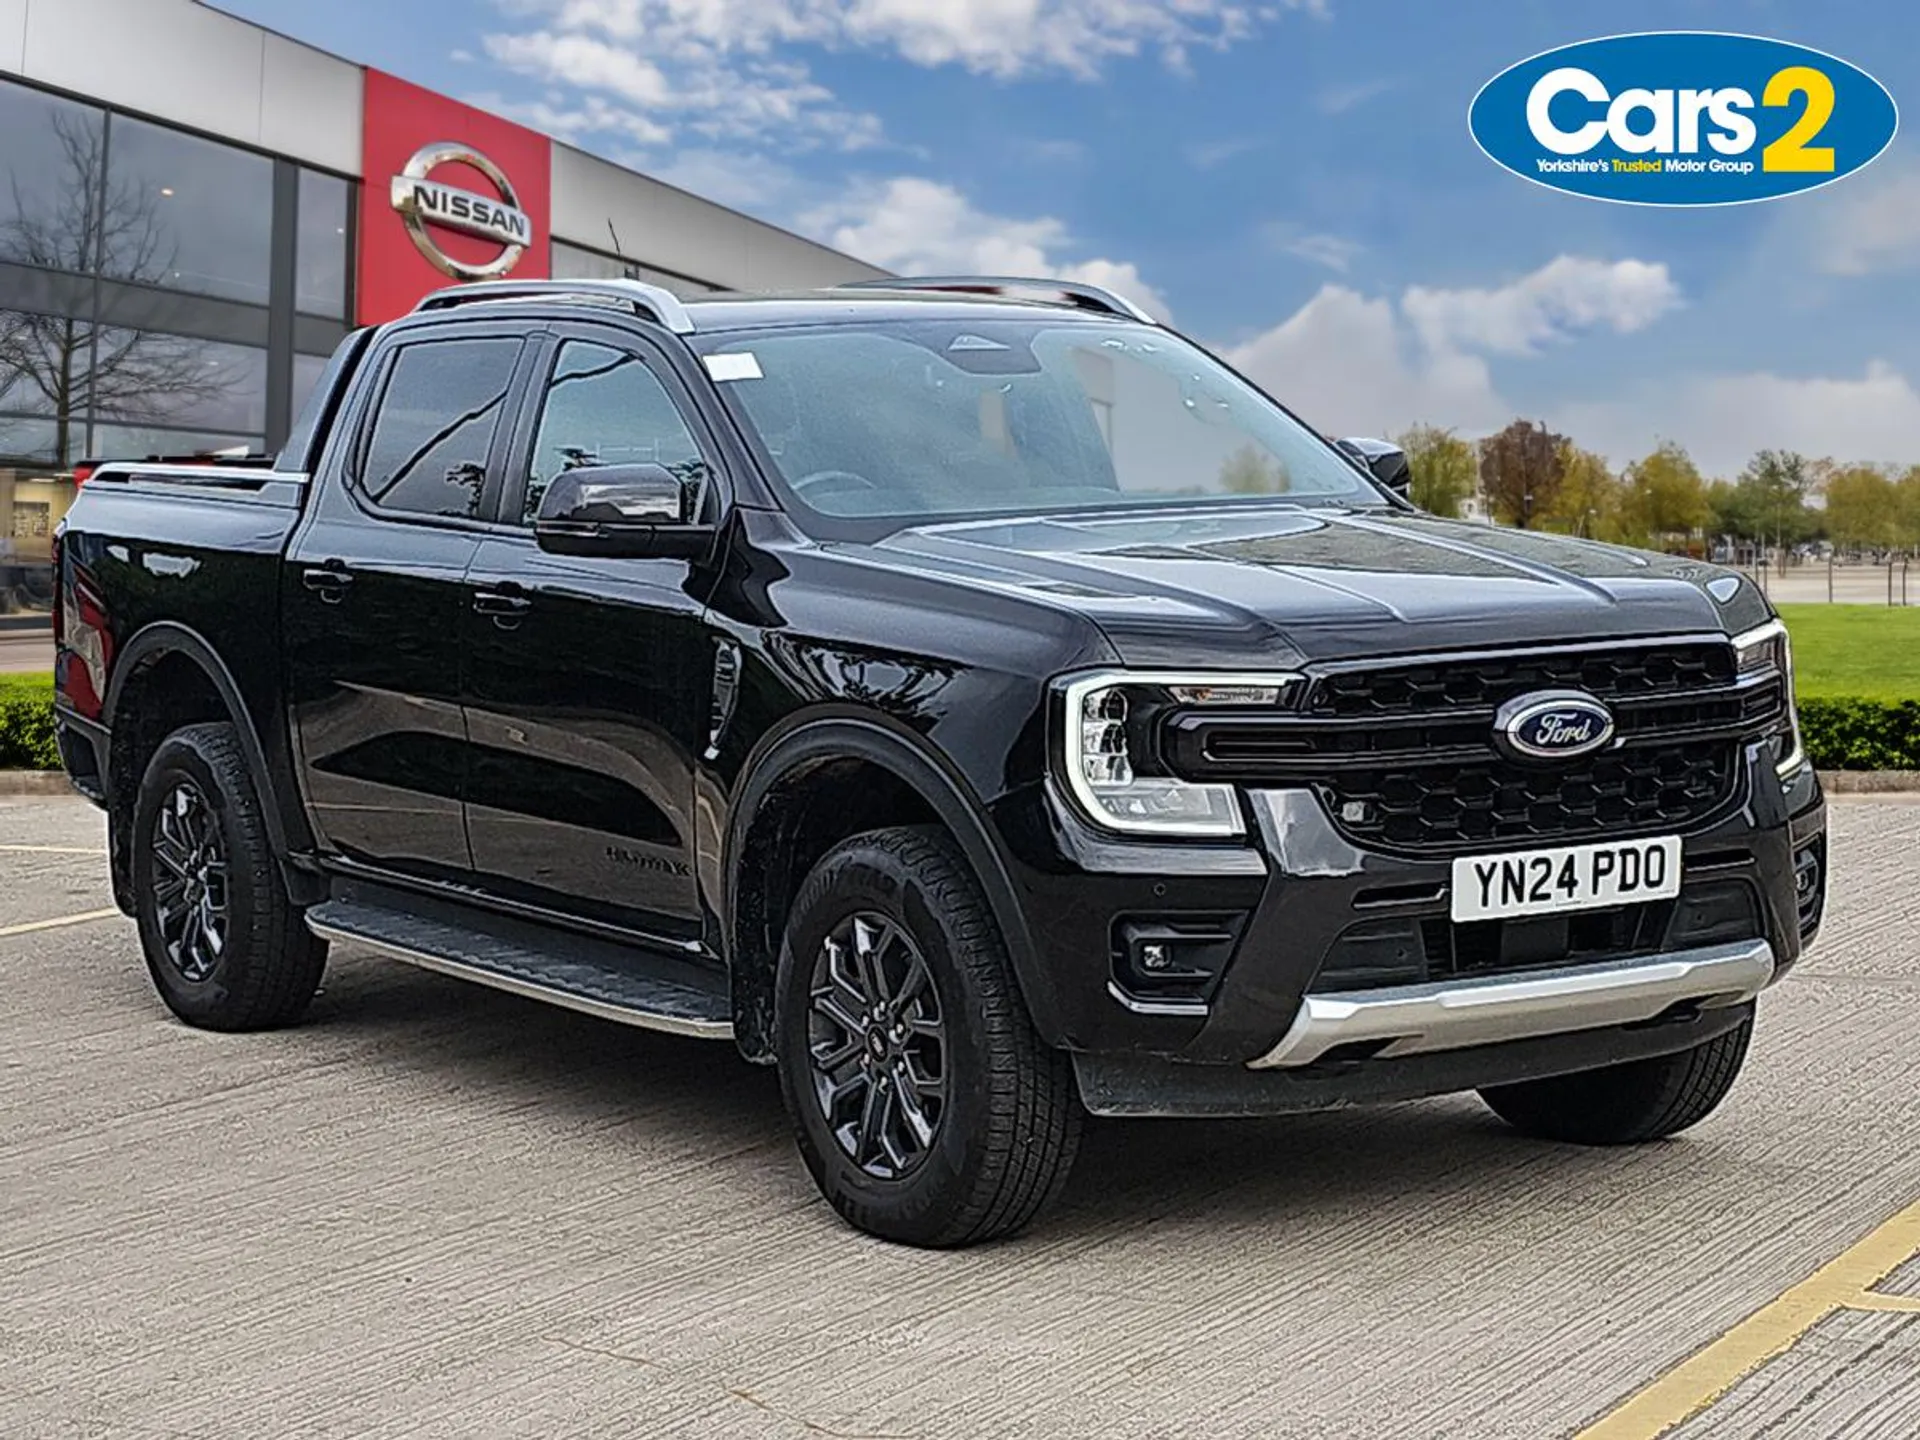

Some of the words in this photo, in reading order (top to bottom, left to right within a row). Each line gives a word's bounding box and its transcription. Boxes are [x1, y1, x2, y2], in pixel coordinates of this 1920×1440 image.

[413, 185, 525, 237] NISSAN
[1535, 712, 1592, 745] Ford
[1474, 853, 1580, 909] YN24
[1591, 844, 1667, 896] PDO
